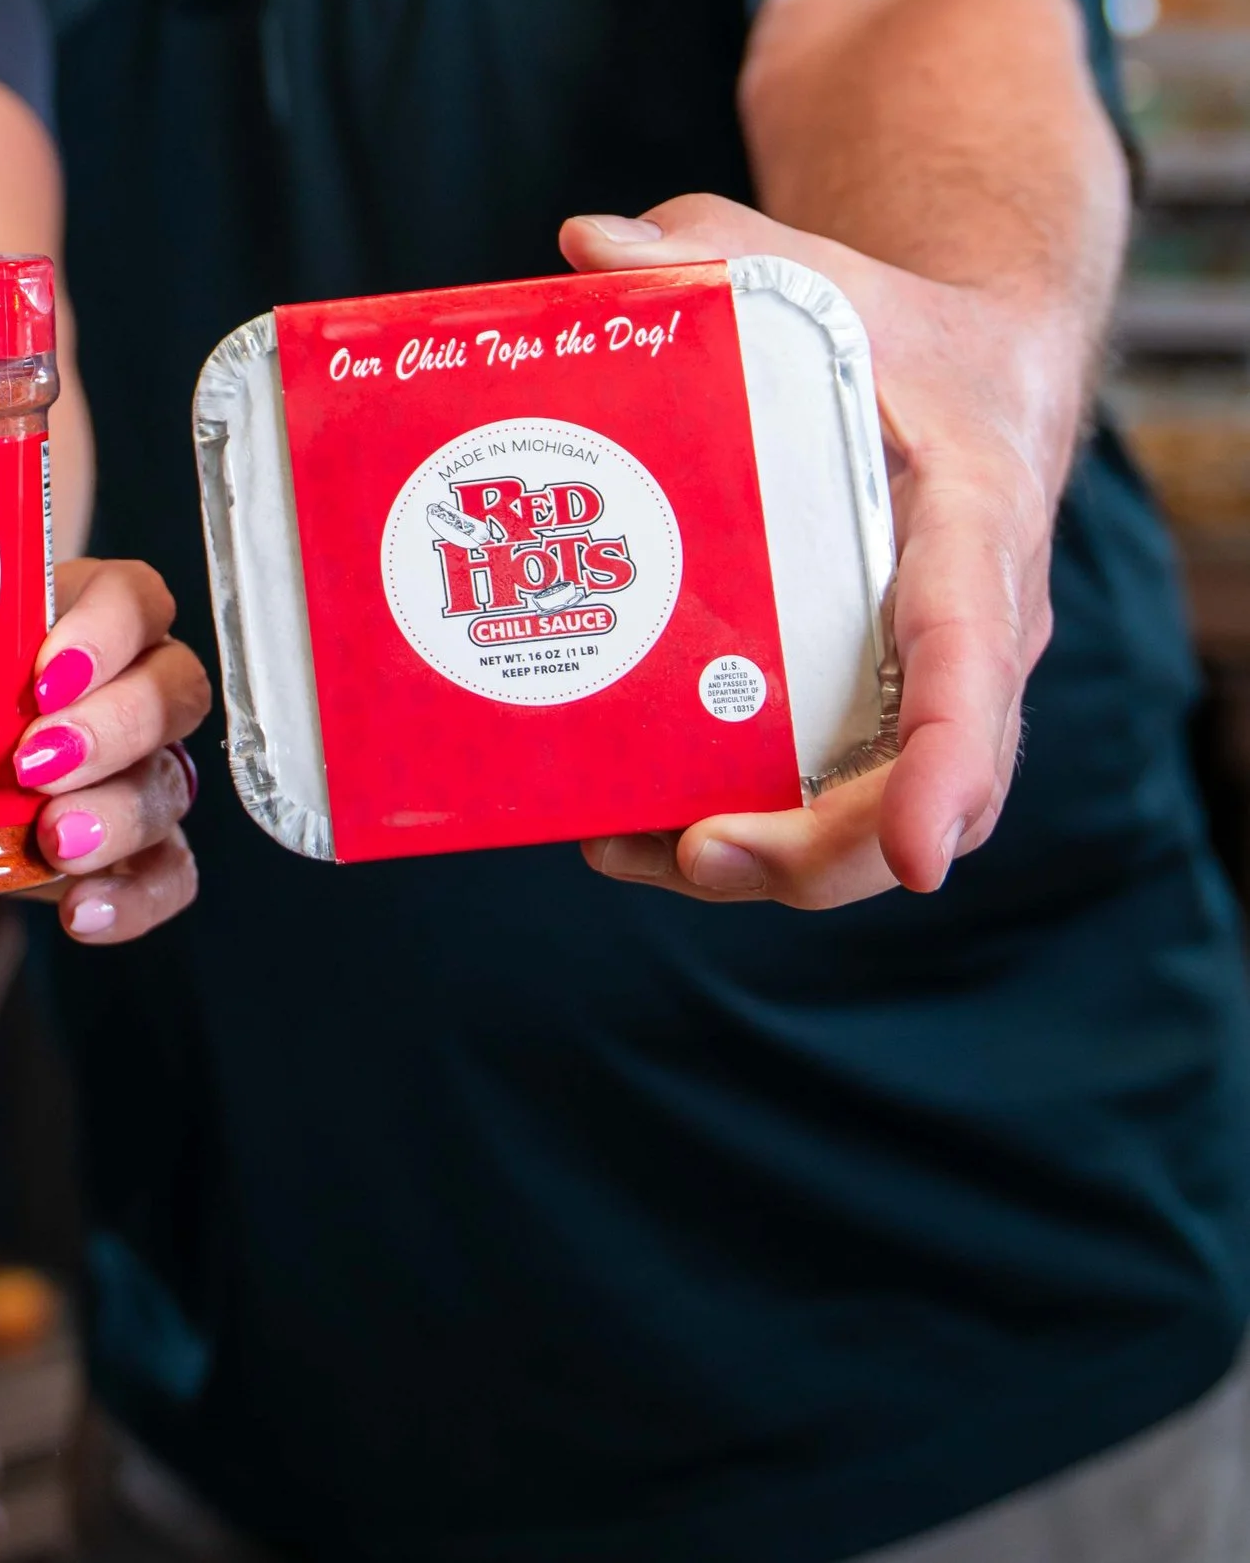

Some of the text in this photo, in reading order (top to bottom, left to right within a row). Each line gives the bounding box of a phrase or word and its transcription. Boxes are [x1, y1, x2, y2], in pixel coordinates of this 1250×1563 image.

[328, 310, 682, 381] Our Chili Tops the Dog!
[438, 439, 599, 482] MADE IN MICHIGAN
[449, 475, 605, 544] RED
[475, 611, 607, 643] CHILI SAUCE
[479, 645, 599, 666] NET WT. 16 OZ (1 LB)
[501, 662, 580, 679] KEEP FROZEN
[721, 661, 740, 671] U.S.
[714, 672, 748, 680] INSPECTED
[708, 687, 749, 697] DEPARTMENT
[712, 695, 756, 704] AGRICULTURE
[733, 704, 755, 713] 10315
